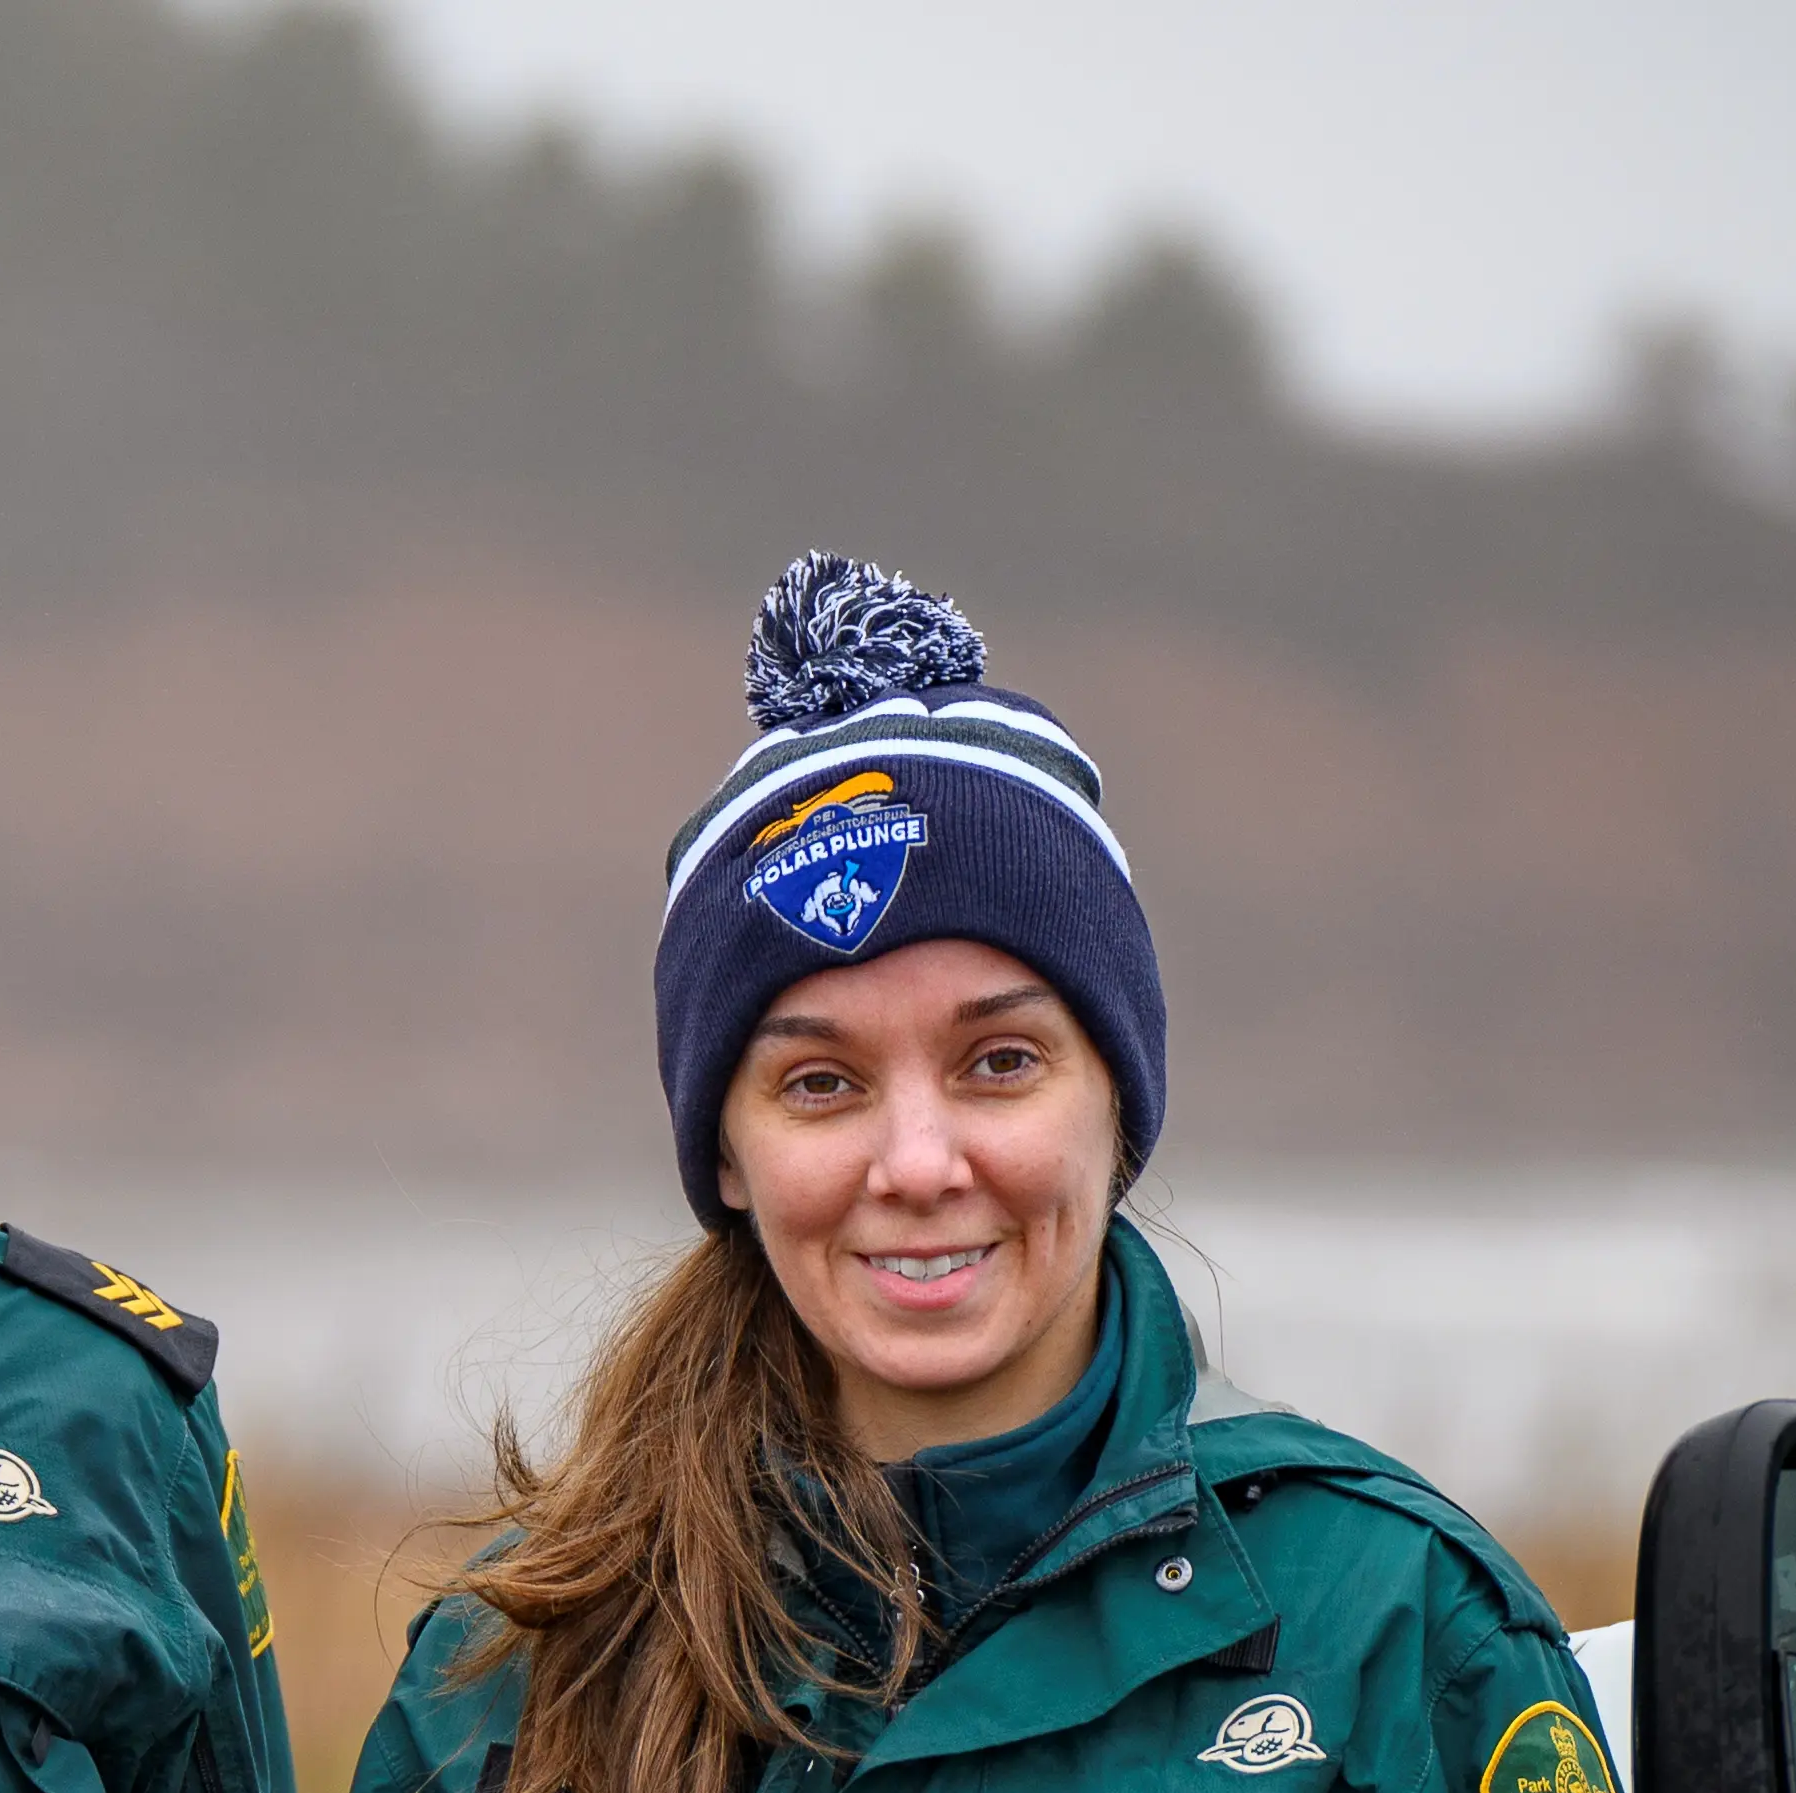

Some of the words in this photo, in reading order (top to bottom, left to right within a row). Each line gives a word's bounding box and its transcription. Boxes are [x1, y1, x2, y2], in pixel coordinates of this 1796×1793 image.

[812, 810, 836, 826] PEI
[749, 841, 828, 894] POLAR
[829, 820, 920, 856] PLUNGE
[1517, 1776, 1553, 1793] Park
